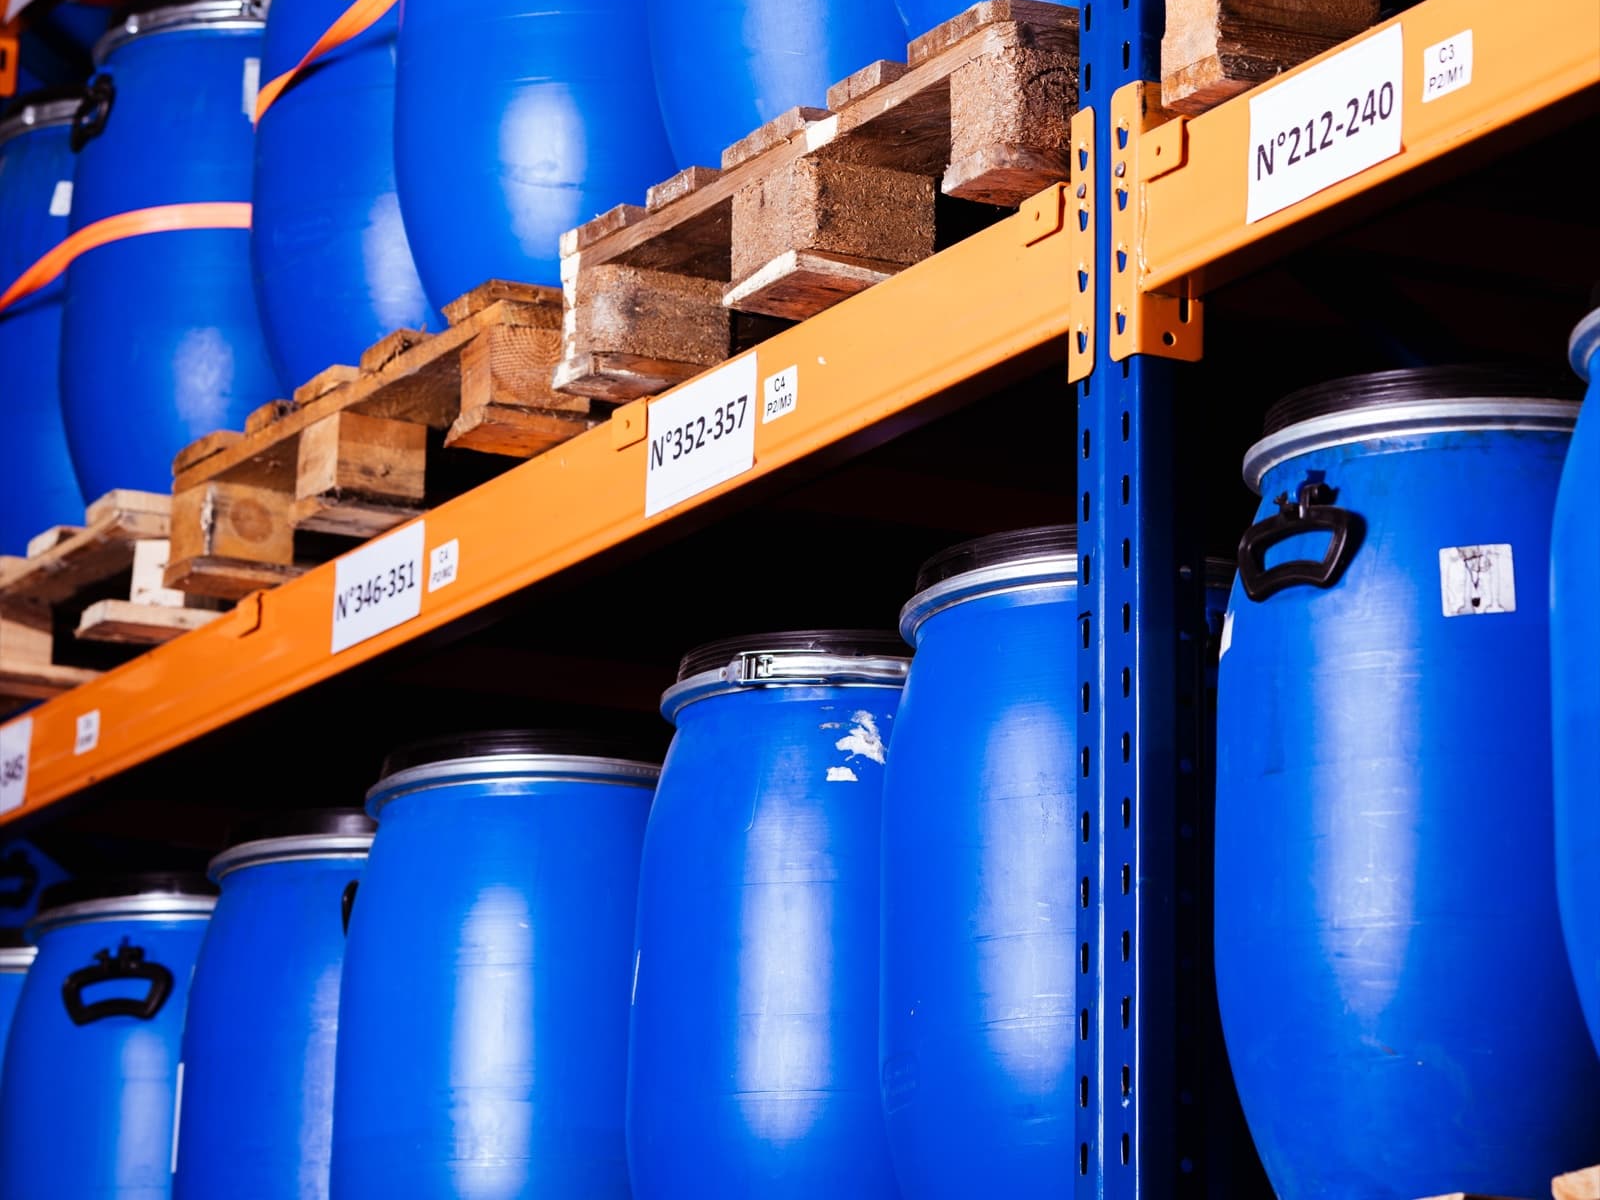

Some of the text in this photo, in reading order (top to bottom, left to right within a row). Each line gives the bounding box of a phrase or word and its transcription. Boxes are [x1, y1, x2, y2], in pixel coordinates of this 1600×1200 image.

[1438, 44, 1455, 64] C3
[1428, 65, 1464, 92] P2/M1
[1256, 80, 1394, 181] N°212-240
[774, 376, 786, 392] C4
[767, 393, 792, 417] P2/M3
[651, 394, 748, 471] N°352-357
[336, 560, 415, 621] N°346-351
